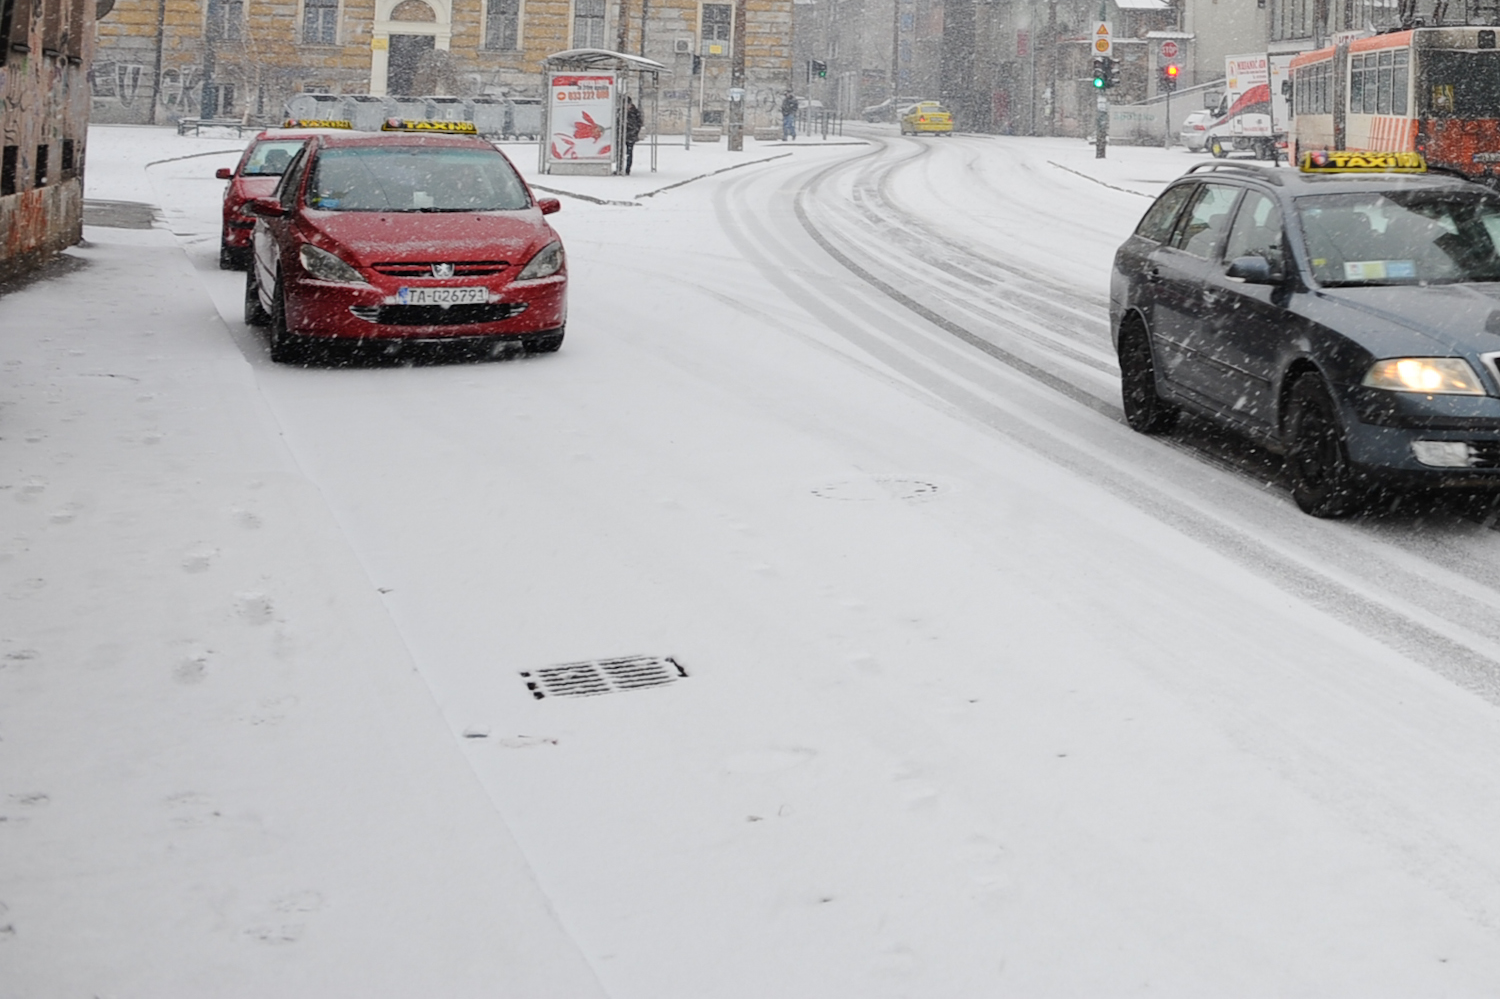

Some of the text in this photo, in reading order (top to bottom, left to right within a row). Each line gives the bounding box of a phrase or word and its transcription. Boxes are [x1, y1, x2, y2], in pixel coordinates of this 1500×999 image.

[1162, 46, 1178, 55] STOP
[403, 120, 455, 130] TAXI
[1329, 157, 1396, 168] TAXI
